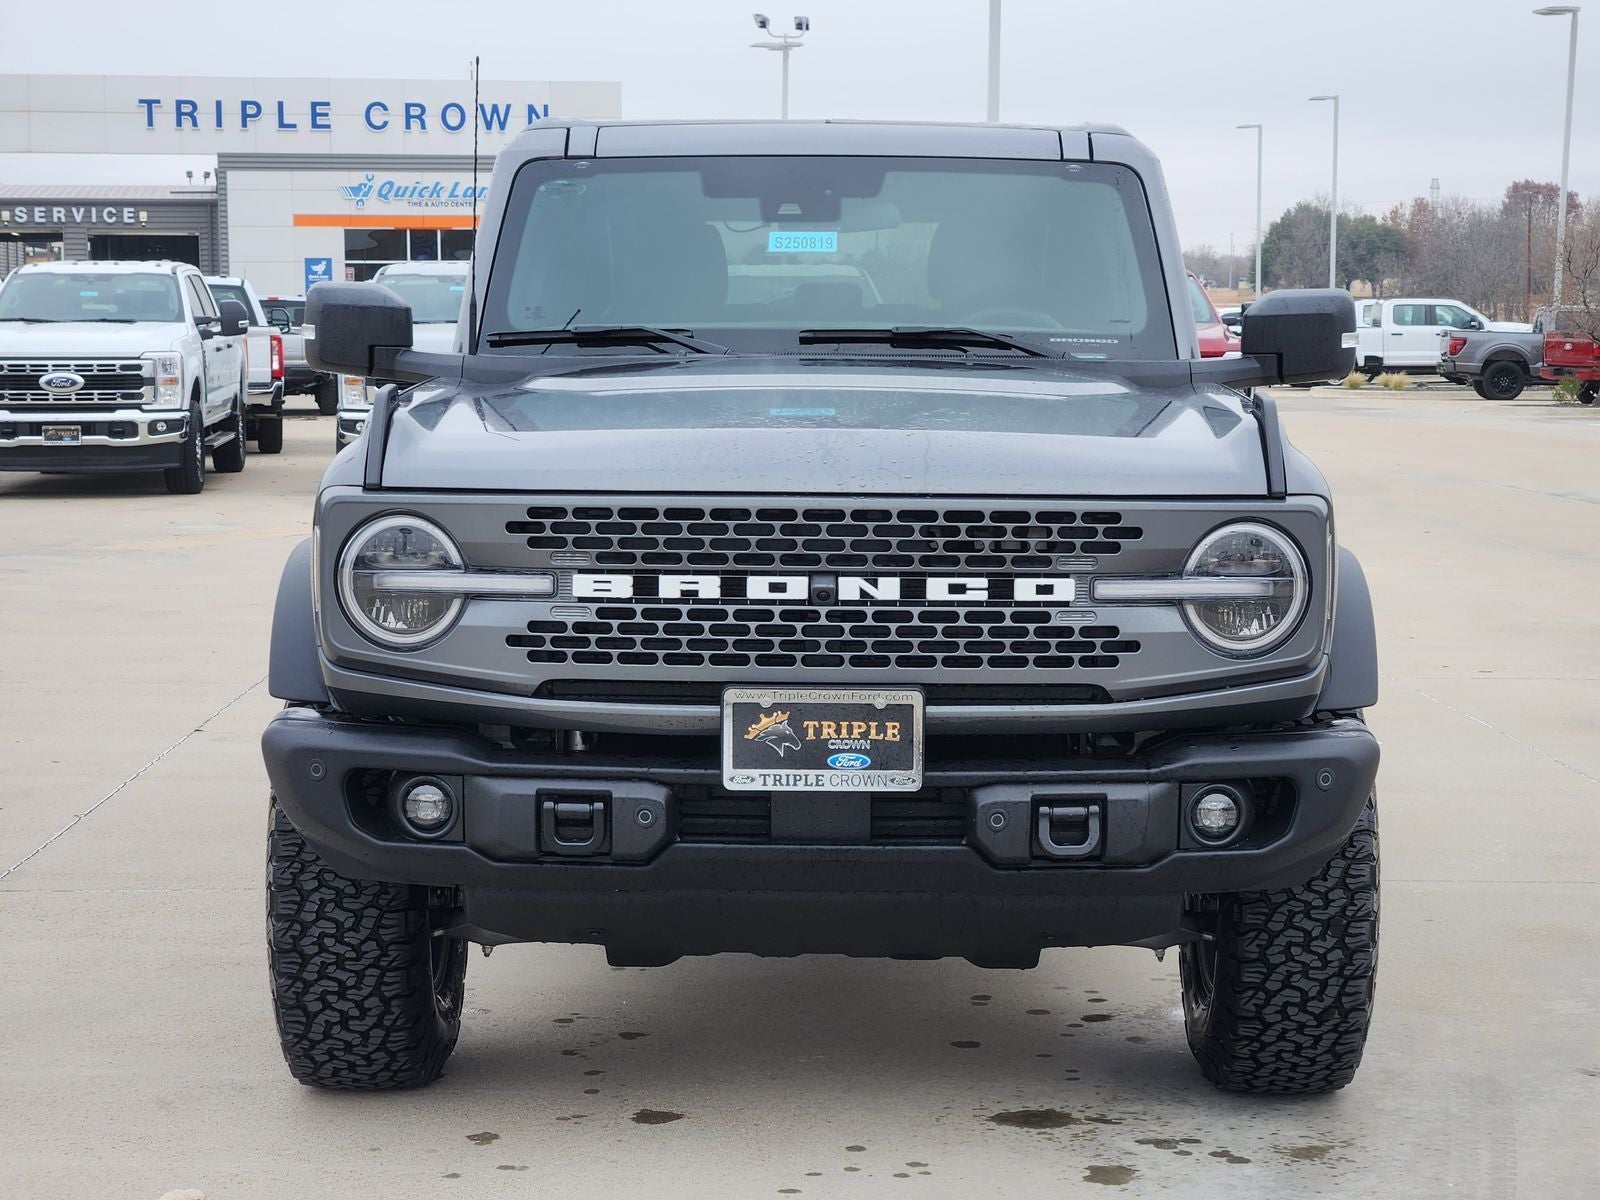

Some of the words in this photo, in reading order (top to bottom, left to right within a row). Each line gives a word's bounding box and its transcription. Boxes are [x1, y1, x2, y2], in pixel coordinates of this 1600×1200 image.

[137, 98, 332, 130] TRIPLE
[363, 100, 551, 132] CROWN
[377, 180, 445, 202] Quick
[447, 181, 489, 199] Lan
[14, 206, 136, 223] SERVICE
[774, 236, 834, 249] S250819
[48, 377, 75, 388] Ford
[572, 573, 1076, 601] BRONCO
[734, 690, 914, 702] www.TripleCrownFord.com
[802, 720, 901, 742] TRIPLE
[827, 739, 871, 750] CROWN
[833, 755, 866, 768] Ford
[732, 774, 753, 785] Ford
[758, 773, 826, 787] TRIPLE
[828, 773, 889, 788] CROWN
[893, 776, 914, 785] Ford
